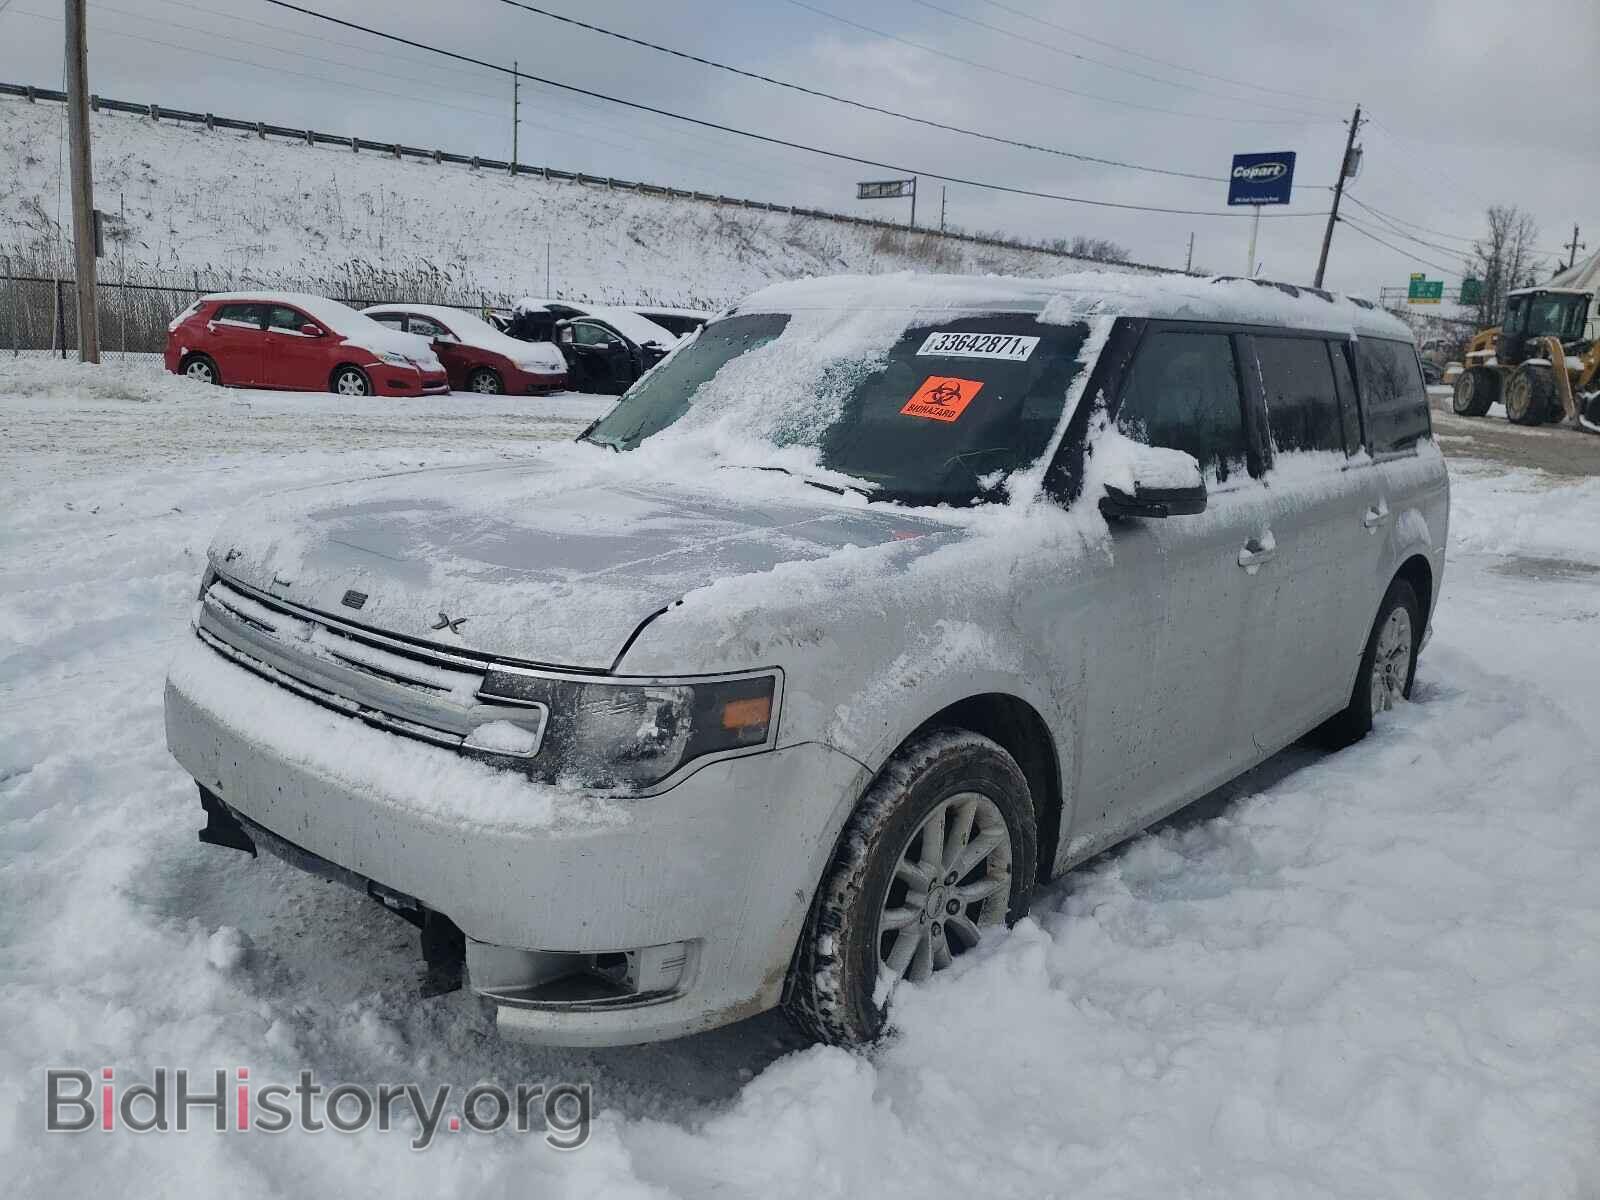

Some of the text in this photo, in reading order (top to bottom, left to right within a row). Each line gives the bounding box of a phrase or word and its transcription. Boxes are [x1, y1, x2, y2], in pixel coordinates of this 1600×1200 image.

[1233, 164, 1281, 179] Copart
[934, 334, 1022, 355] 33642871
[906, 403, 956, 418] BIOHAZARD
